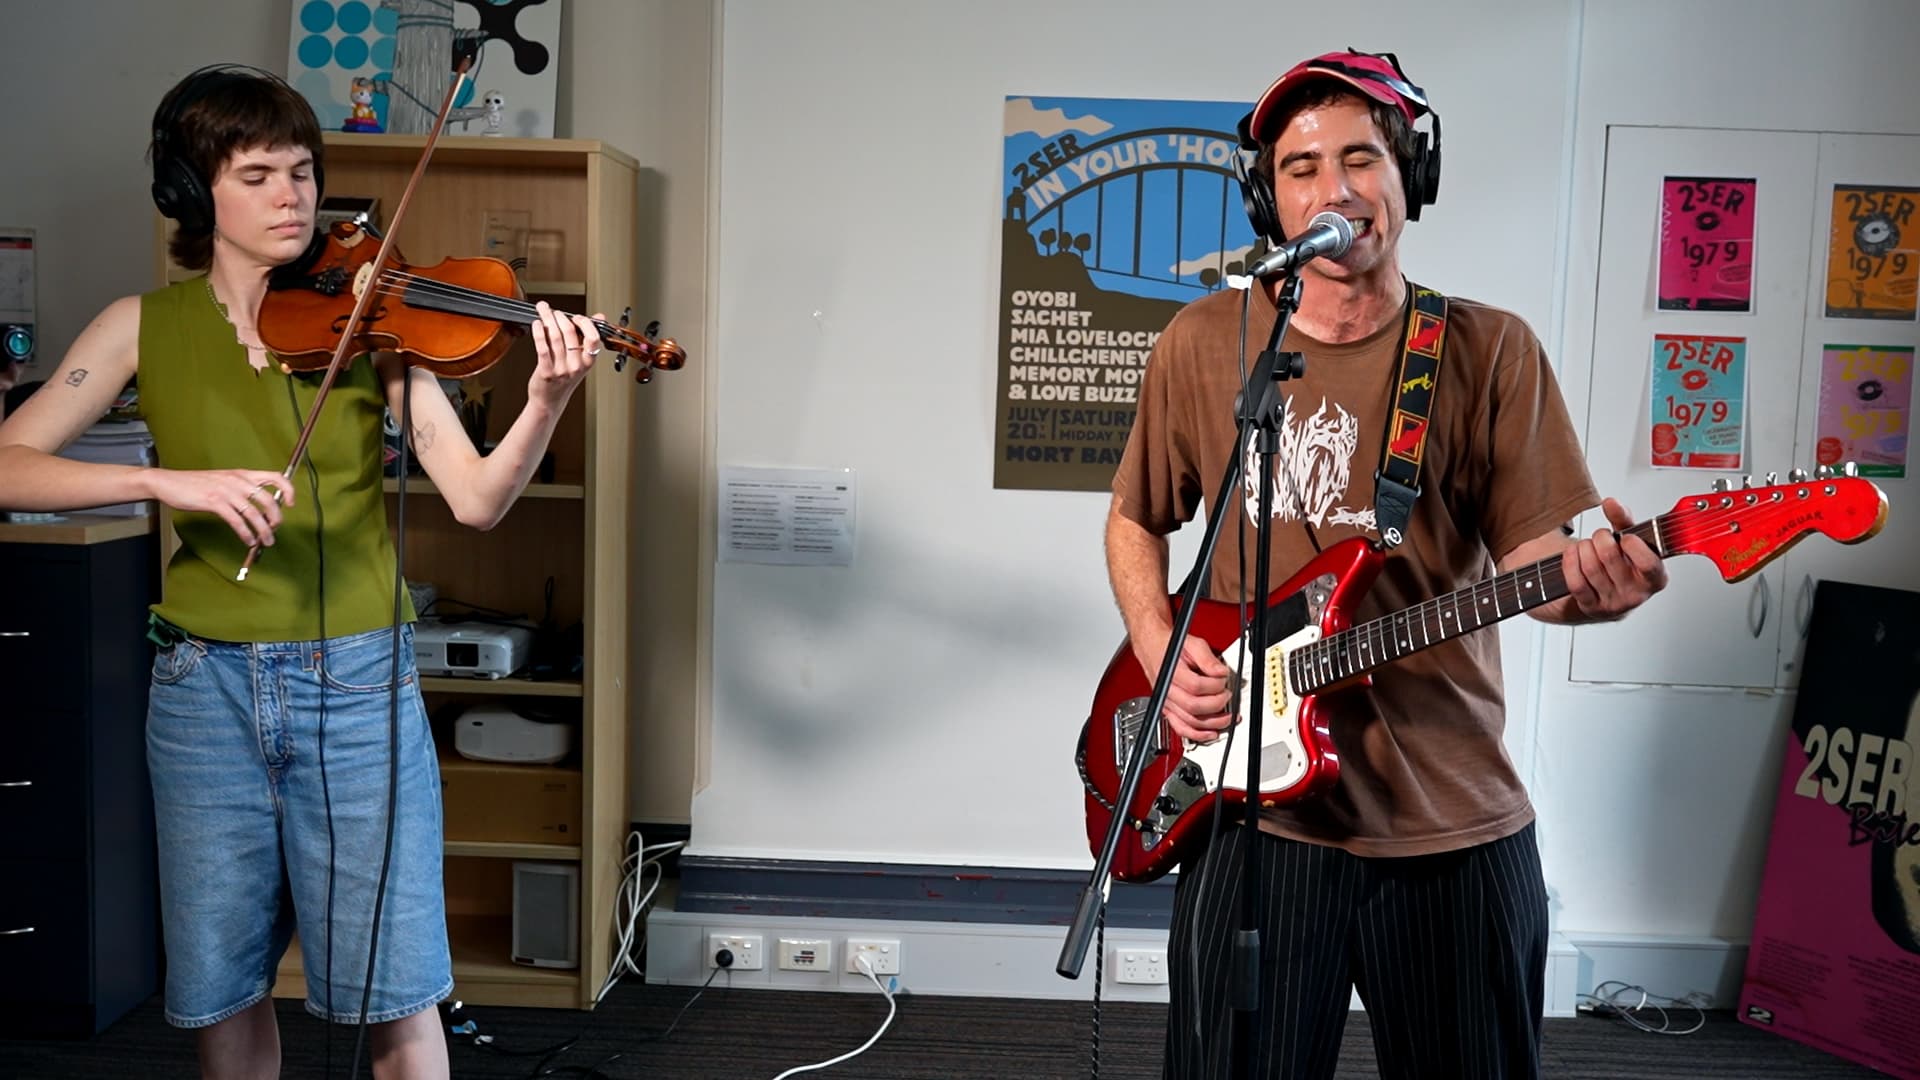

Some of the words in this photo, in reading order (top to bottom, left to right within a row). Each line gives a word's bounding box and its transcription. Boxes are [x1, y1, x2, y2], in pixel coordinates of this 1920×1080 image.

[1012, 134, 1083, 186] 2SER
[1024, 170, 1069, 211] IN
[1066, 138, 1161, 184] YOUR
[1677, 181, 1745, 215] 2SER
[1845, 191, 1915, 226] 2SER
[1680, 236, 1739, 268] 1979
[1847, 247, 1908, 281] 1979
[1011, 290, 1076, 308] OYOBI
[1010, 309, 1093, 327] SACHET
[1010, 328, 1050, 345] MIA
[1055, 330, 1164, 348] LOVELOCK
[1009, 346, 1151, 366] CHILLCHENEY
[1664, 340, 1735, 375] 2SER
[1837, 347, 1908, 384] 2SER
[1009, 365, 1100, 384] MEMORY
[1008, 384, 1027, 400] &
[1031, 385, 1080, 401] LOVE
[1085, 386, 1137, 403] BUZZ
[1007, 407, 1050, 422] JULY
[1666, 395, 1728, 429] 1979
[1840, 405, 1902, 439] 1979
[1059, 430, 1112, 441] MIDDAY
[1006, 446, 1075, 463] MORT
[1775, 511, 1824, 538] JAGUAR
[1793, 724, 1914, 817] 2SER
